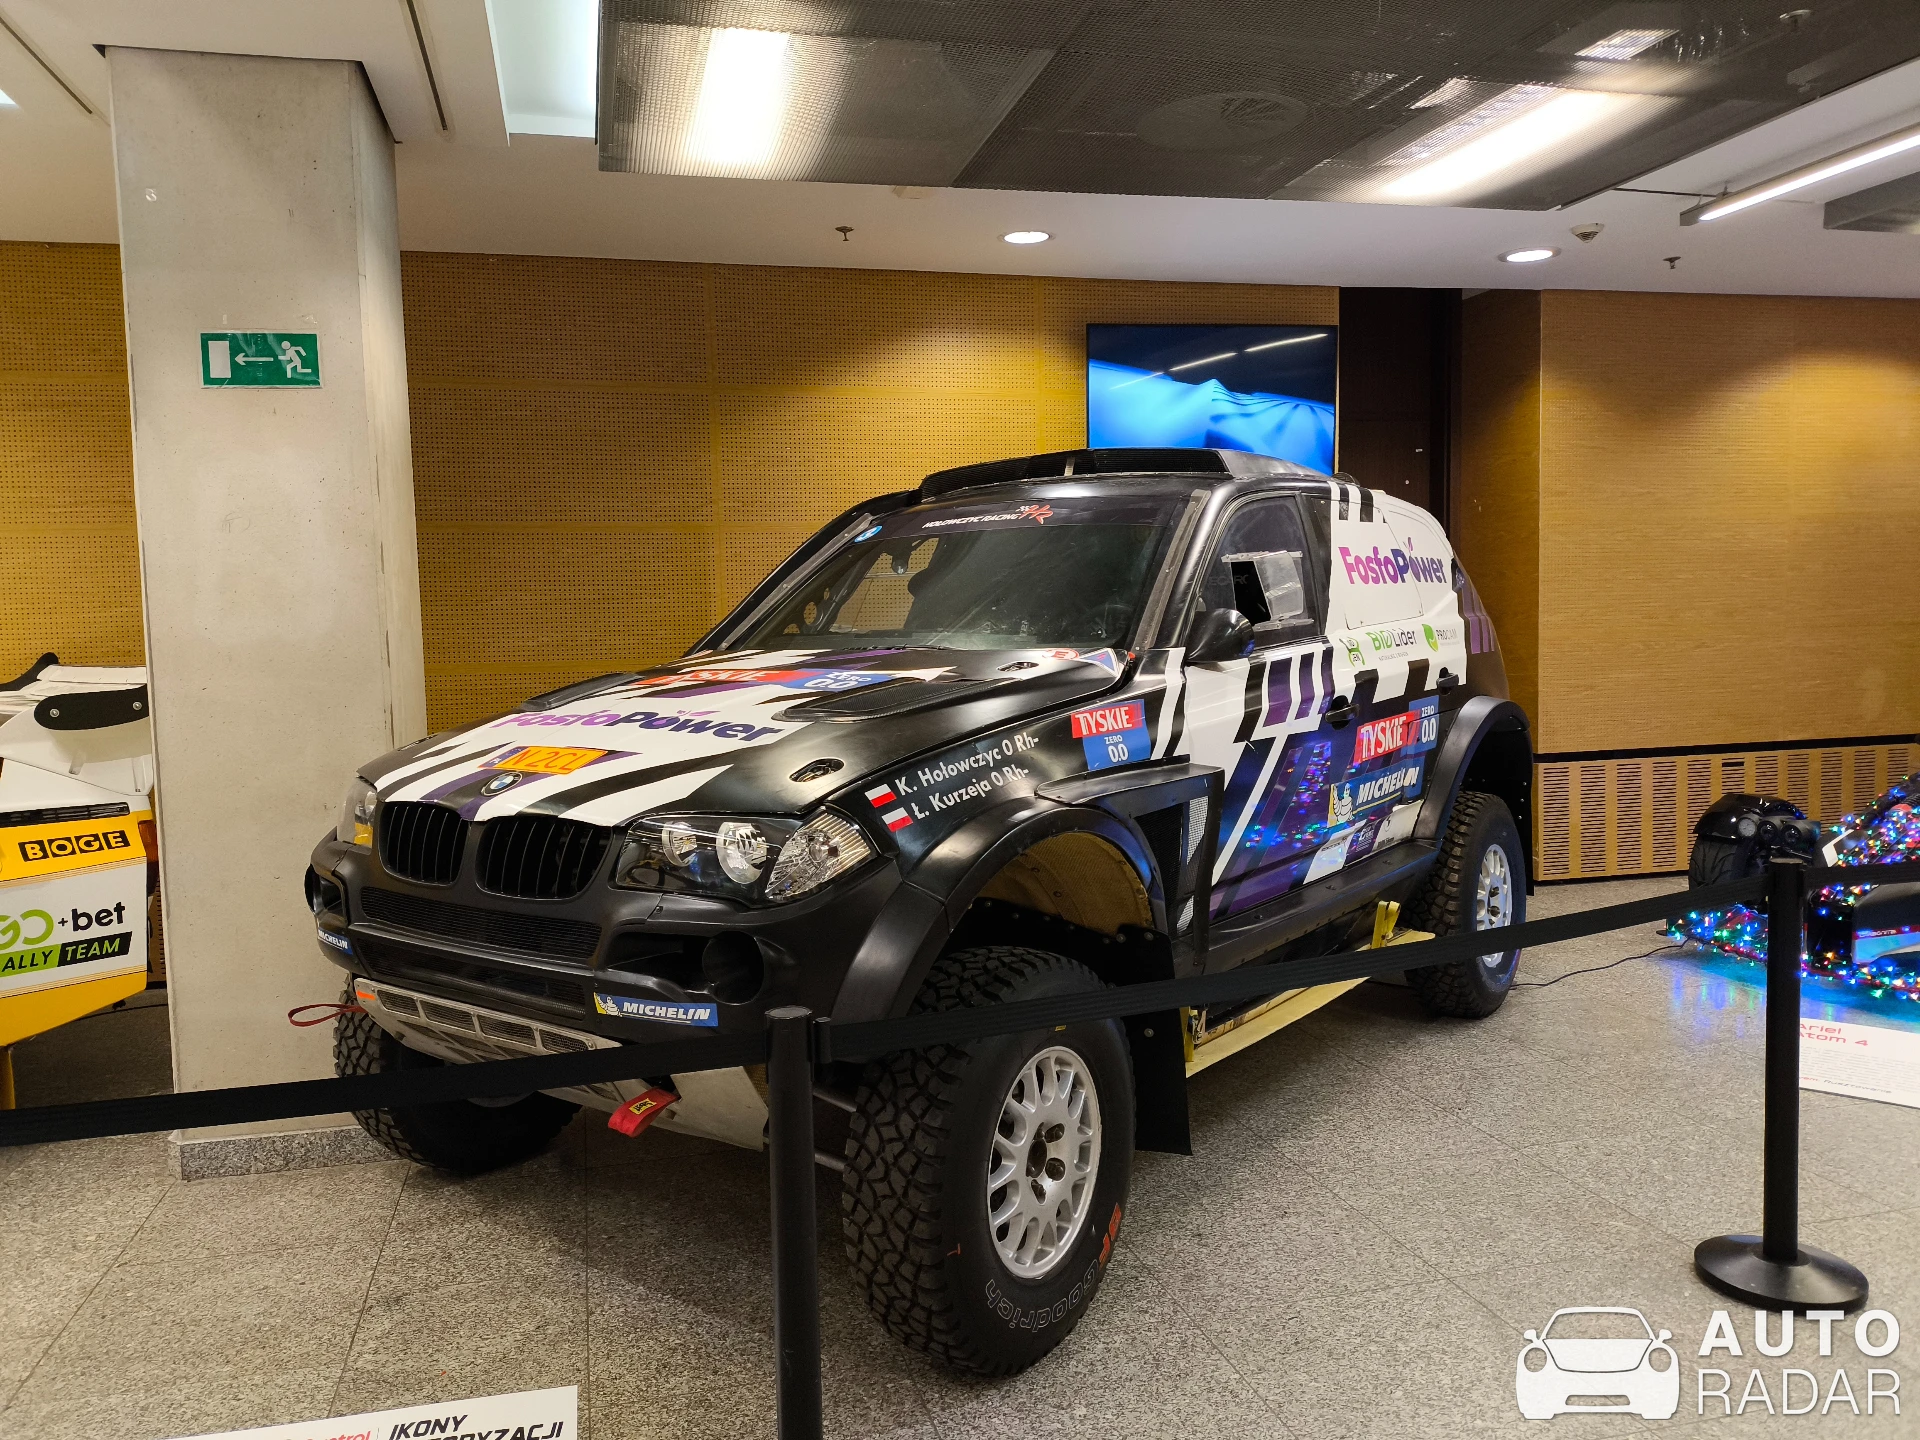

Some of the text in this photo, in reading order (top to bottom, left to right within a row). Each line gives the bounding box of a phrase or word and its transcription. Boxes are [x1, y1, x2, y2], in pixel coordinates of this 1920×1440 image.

[1338, 546, 1447, 585] FosfoPower
[804, 678, 860, 689] 0.0
[824, 671, 872, 682] ZERO
[1075, 707, 1133, 735] TYSKIE
[1422, 706, 1435, 717] ZERO
[489, 709, 785, 742] FosfoPower
[1360, 715, 1408, 759] TYSKIE
[1421, 717, 1437, 744] 0.0
[1104, 734, 1123, 745] ZERO
[1108, 743, 1129, 763] 0.0
[895, 776, 918, 796] K.
[918, 748, 1001, 787] Hołowczyc
[1014, 731, 1040, 752] Rh-
[911, 802, 930, 820] Ł.
[929, 780, 992, 813] Kurzeja
[1002, 763, 1030, 782] Rh-
[1356, 767, 1420, 806] MICHELIN
[18, 830, 131, 862] BOGE
[318, 929, 348, 949] MICHELIN
[1, 937, 121, 973] ALLY TEAM
[623, 1002, 711, 1020] MICHELIN
[389, 1414, 468, 1440] IKONY
